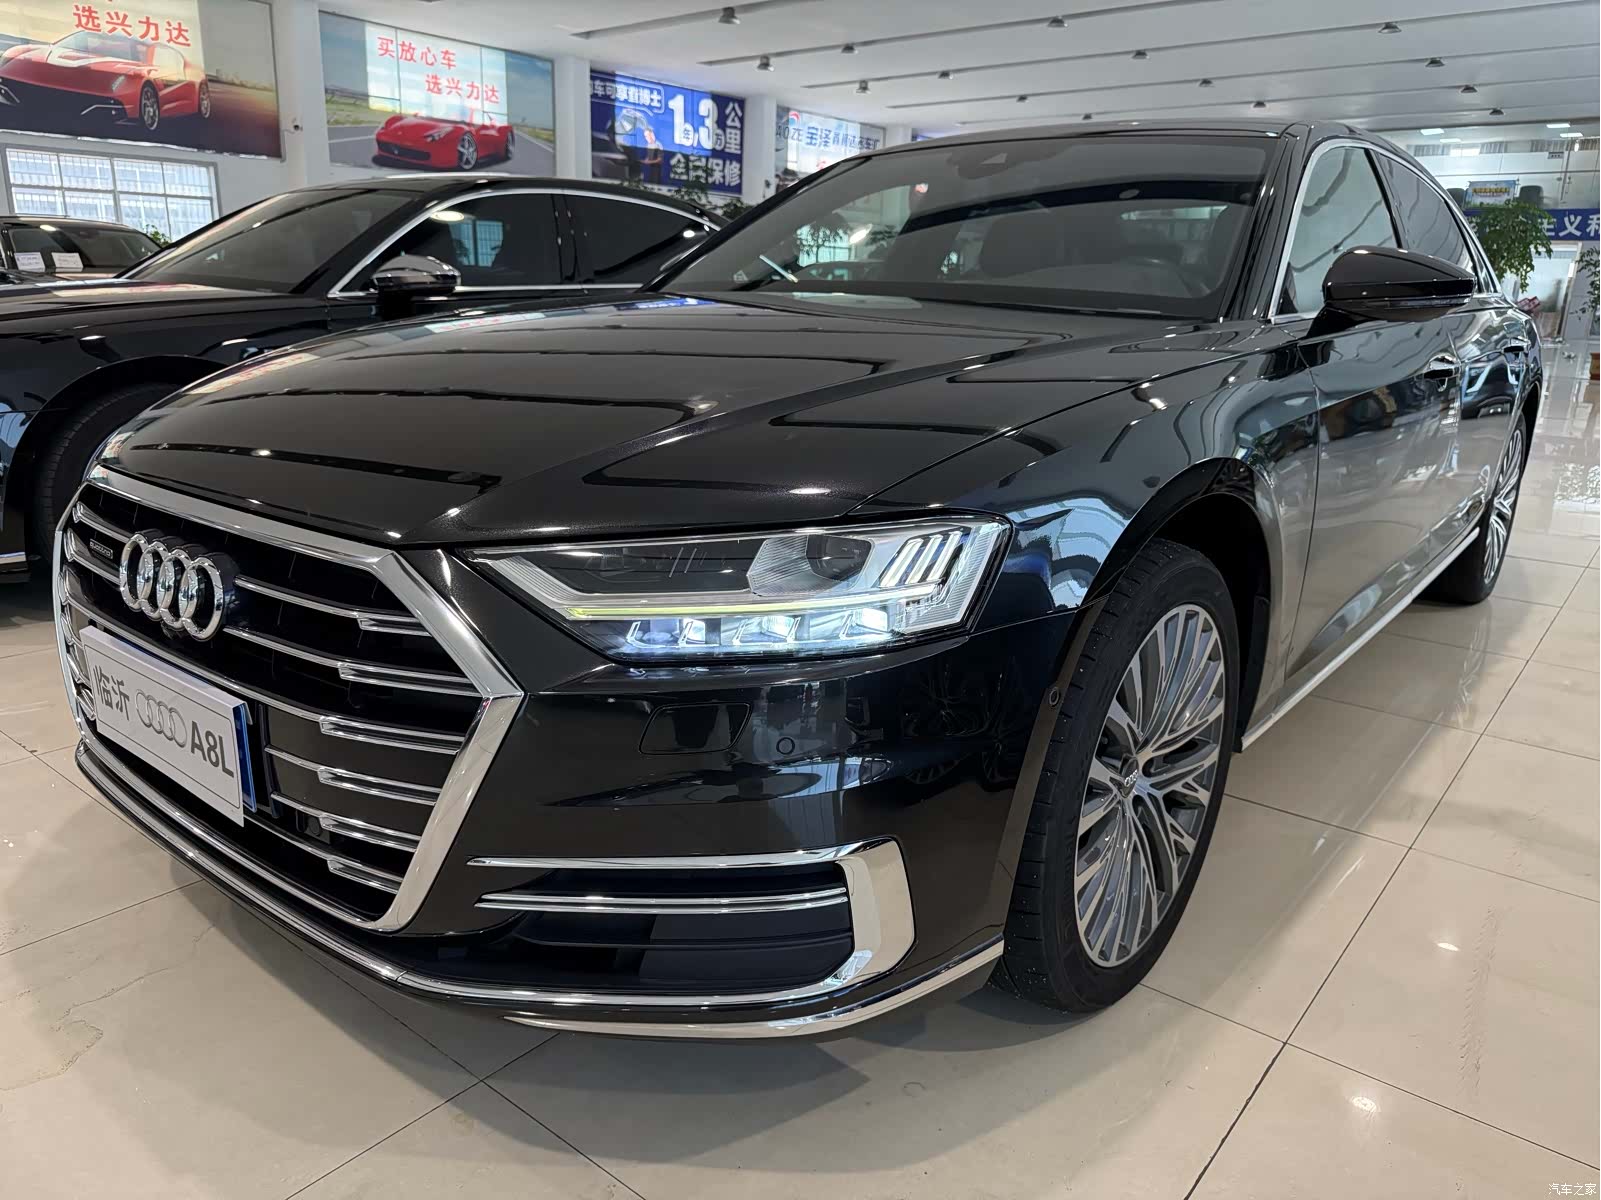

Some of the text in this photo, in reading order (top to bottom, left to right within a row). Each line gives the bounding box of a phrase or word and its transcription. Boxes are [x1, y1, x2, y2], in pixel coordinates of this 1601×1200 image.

[73, 4, 191, 47] 选兴力达
[377, 36, 456, 70] 买放心车
[425, 73, 500, 104] 选兴力达
[93, 664, 235, 778] 临沂 A8L
